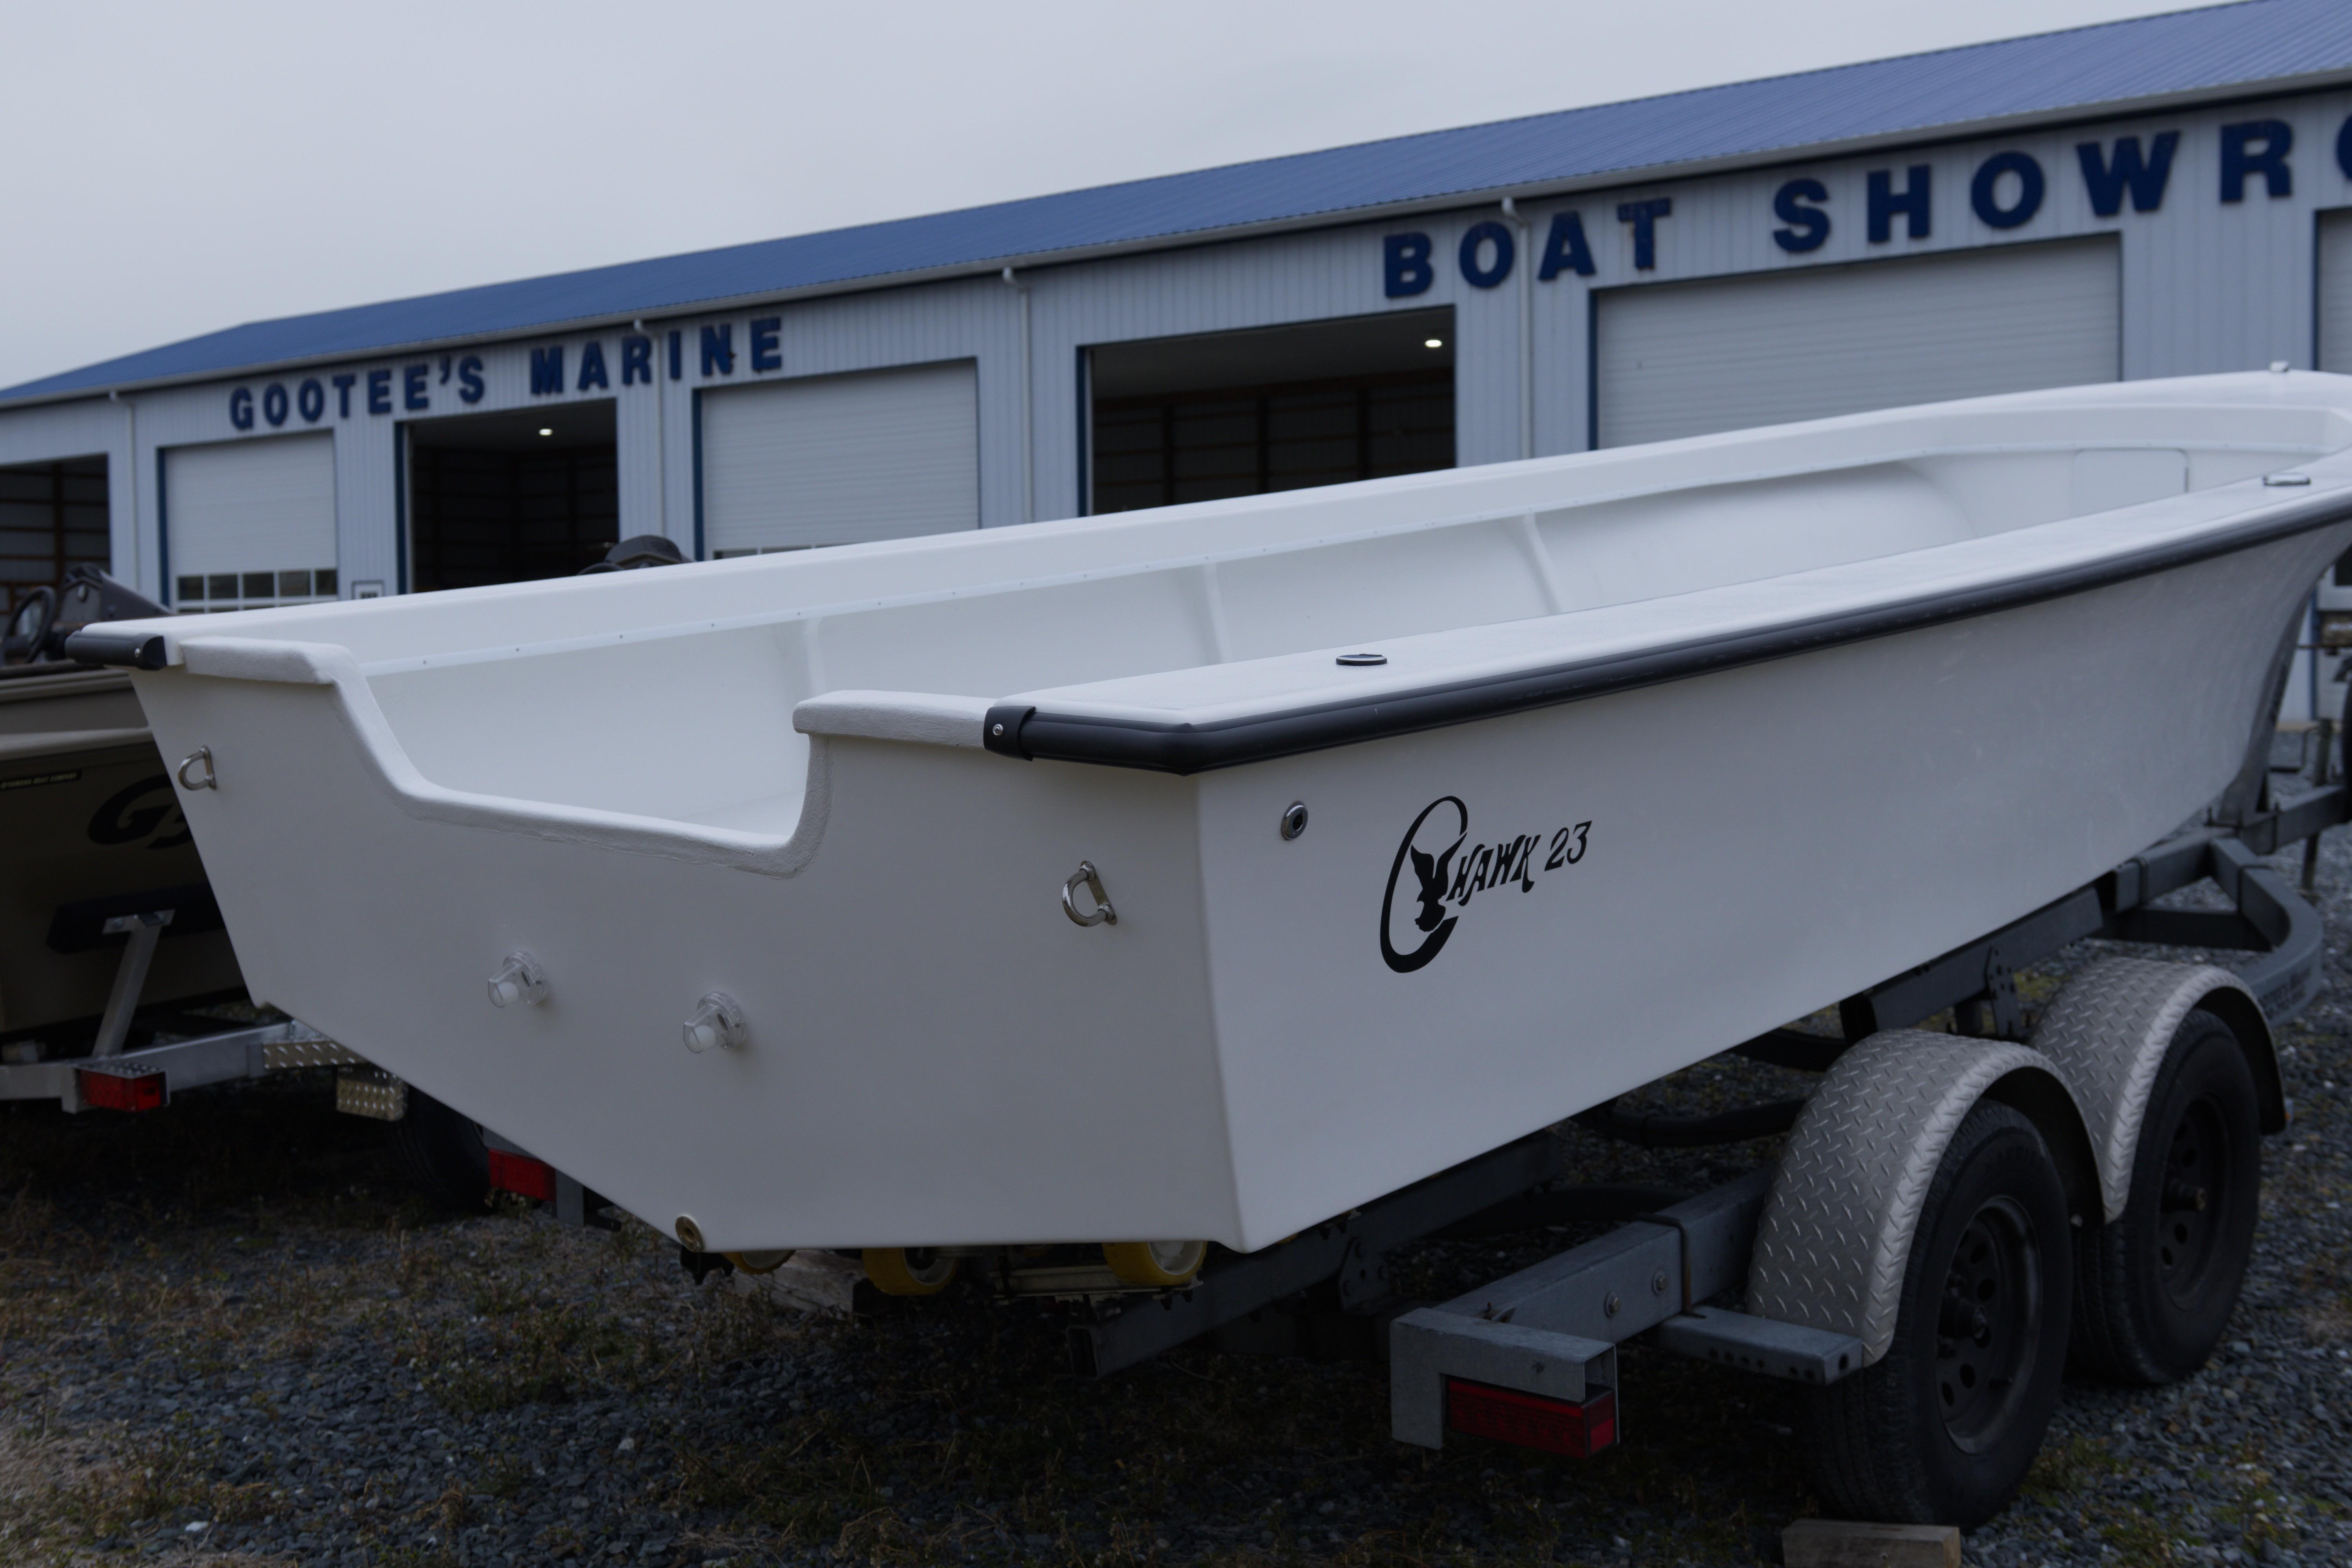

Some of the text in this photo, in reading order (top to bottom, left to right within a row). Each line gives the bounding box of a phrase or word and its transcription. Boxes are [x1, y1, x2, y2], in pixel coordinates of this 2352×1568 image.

[1381, 113, 2352, 300] BOAT SHOWR
[229, 317, 782, 431] GOOTEE'S MARINE
[1445, 834, 1541, 907] HAWK
[1544, 820, 1592, 872] 23
